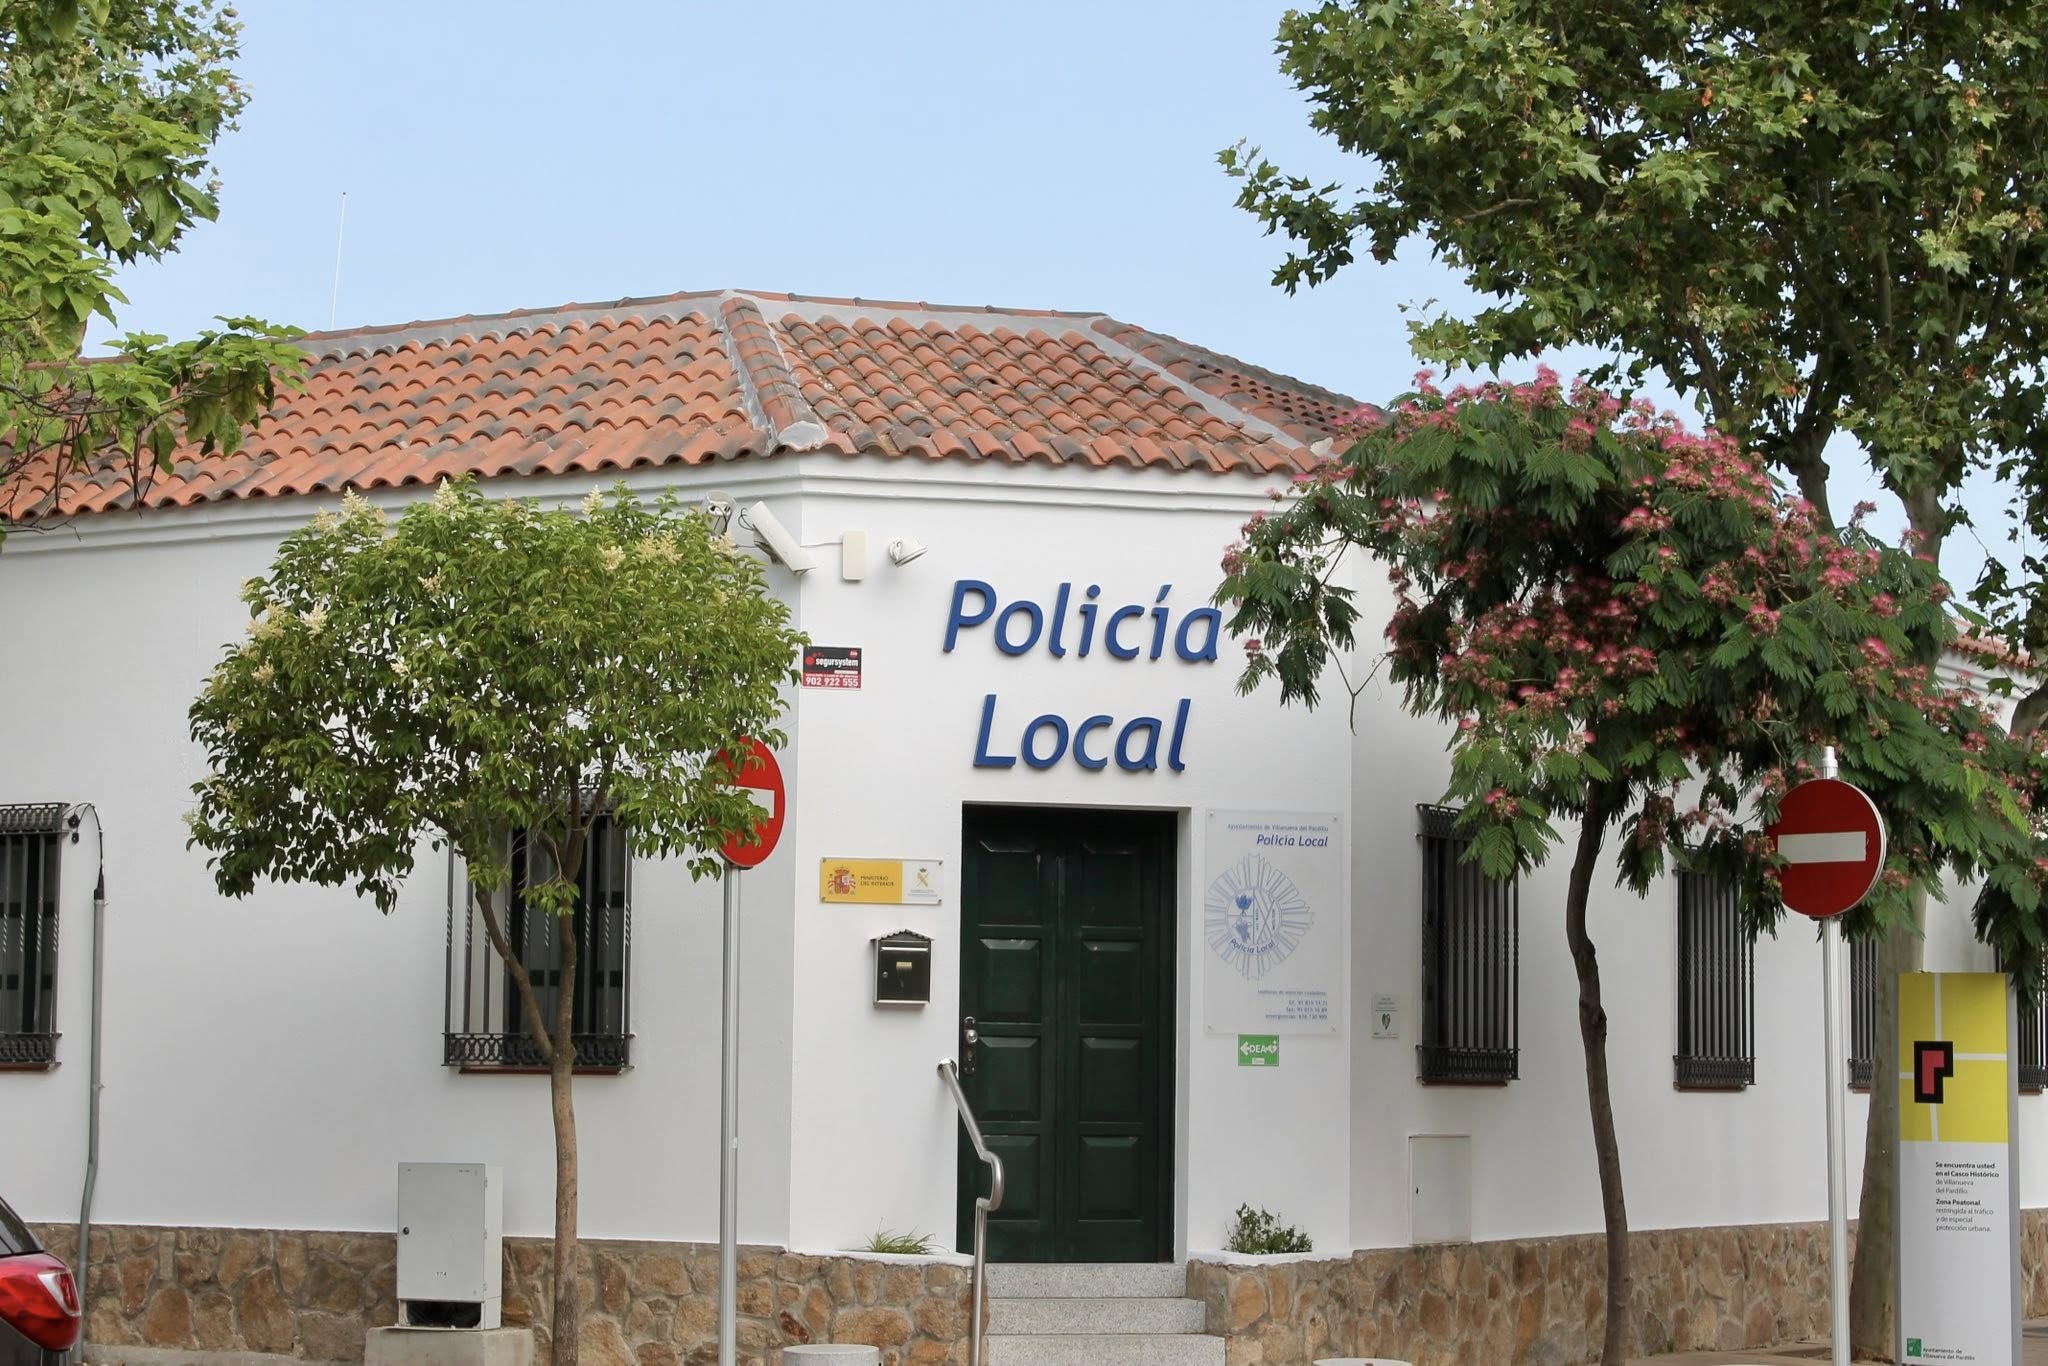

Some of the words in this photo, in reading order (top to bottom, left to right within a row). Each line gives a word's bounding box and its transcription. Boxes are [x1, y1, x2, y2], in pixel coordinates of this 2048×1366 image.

[942, 580, 1222, 661] Policía
[816, 658, 859, 668] segursystem
[805, 677, 821, 685] 902
[824, 677, 840, 686] 922
[842, 678, 858, 687] 555
[973, 694, 1191, 773] Local
[1299, 836, 1329, 847] Local
[1257, 939, 1276, 953] Local
[1250, 1045, 1267, 1053] DEA
